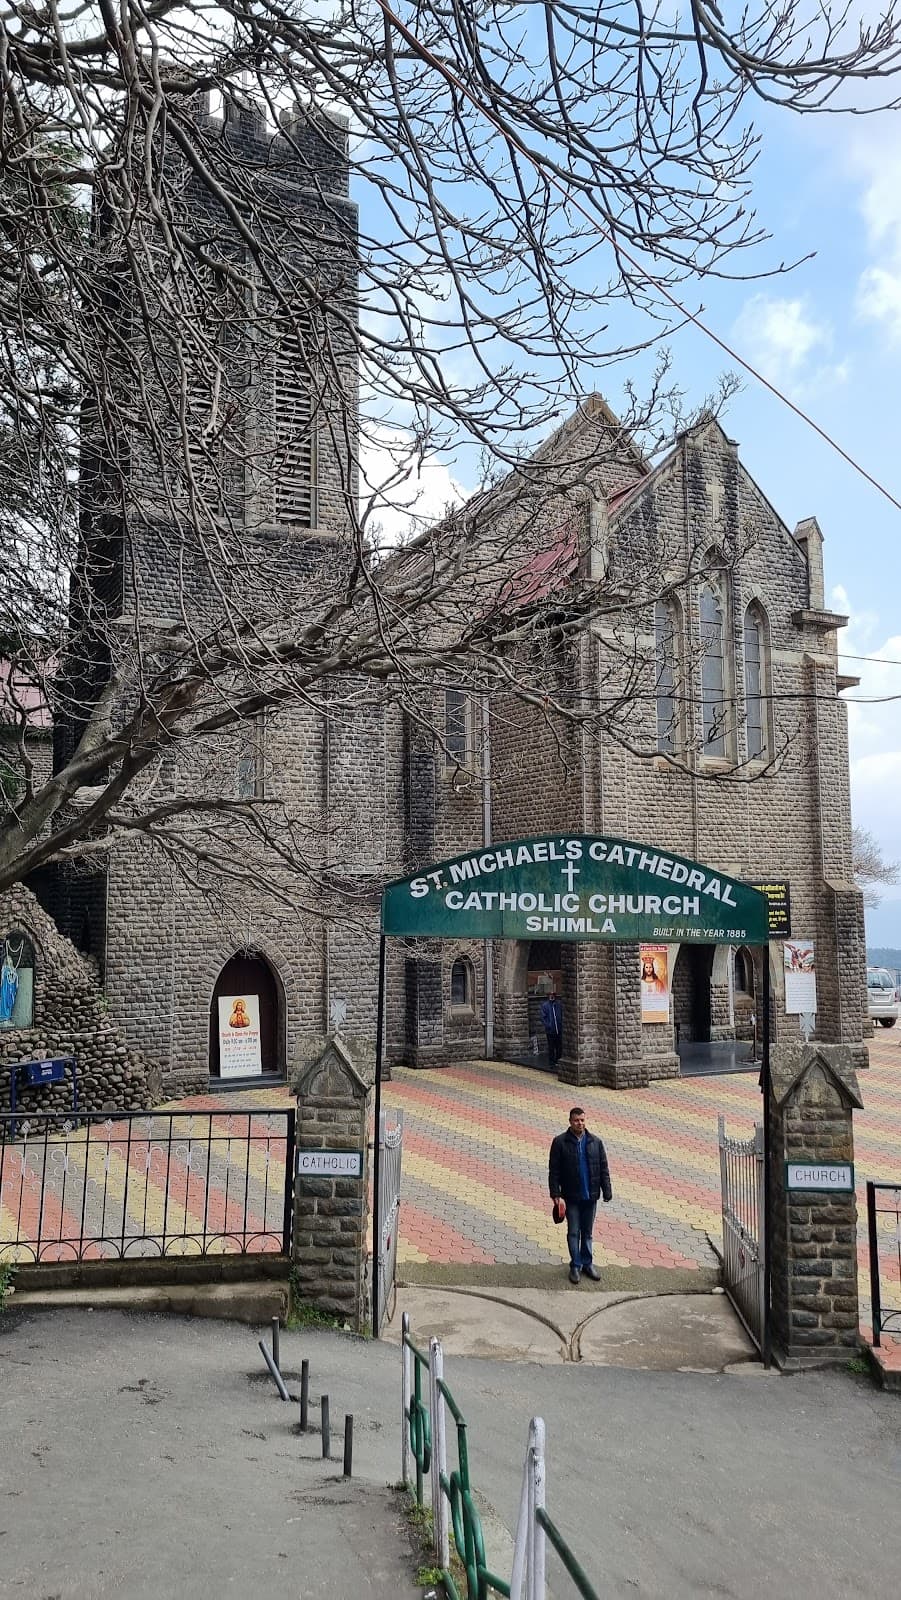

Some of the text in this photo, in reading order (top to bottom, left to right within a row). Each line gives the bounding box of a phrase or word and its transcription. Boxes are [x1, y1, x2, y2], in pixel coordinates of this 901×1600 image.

[410, 839, 738, 908] ST. MICHAEL'S CATHEDRAL
[445, 891, 700, 916] CATHOLIC CHURCH
[526, 916, 617, 933] SHIMLA
[653, 927, 675, 937] BUILT
[676, 928, 684, 937] IN
[686, 928, 701, 938] THE
[702, 928, 725, 938] YEAR
[302, 1156, 357, 1170] CATHOLIC
[795, 1170, 846, 1182] CHURCH
